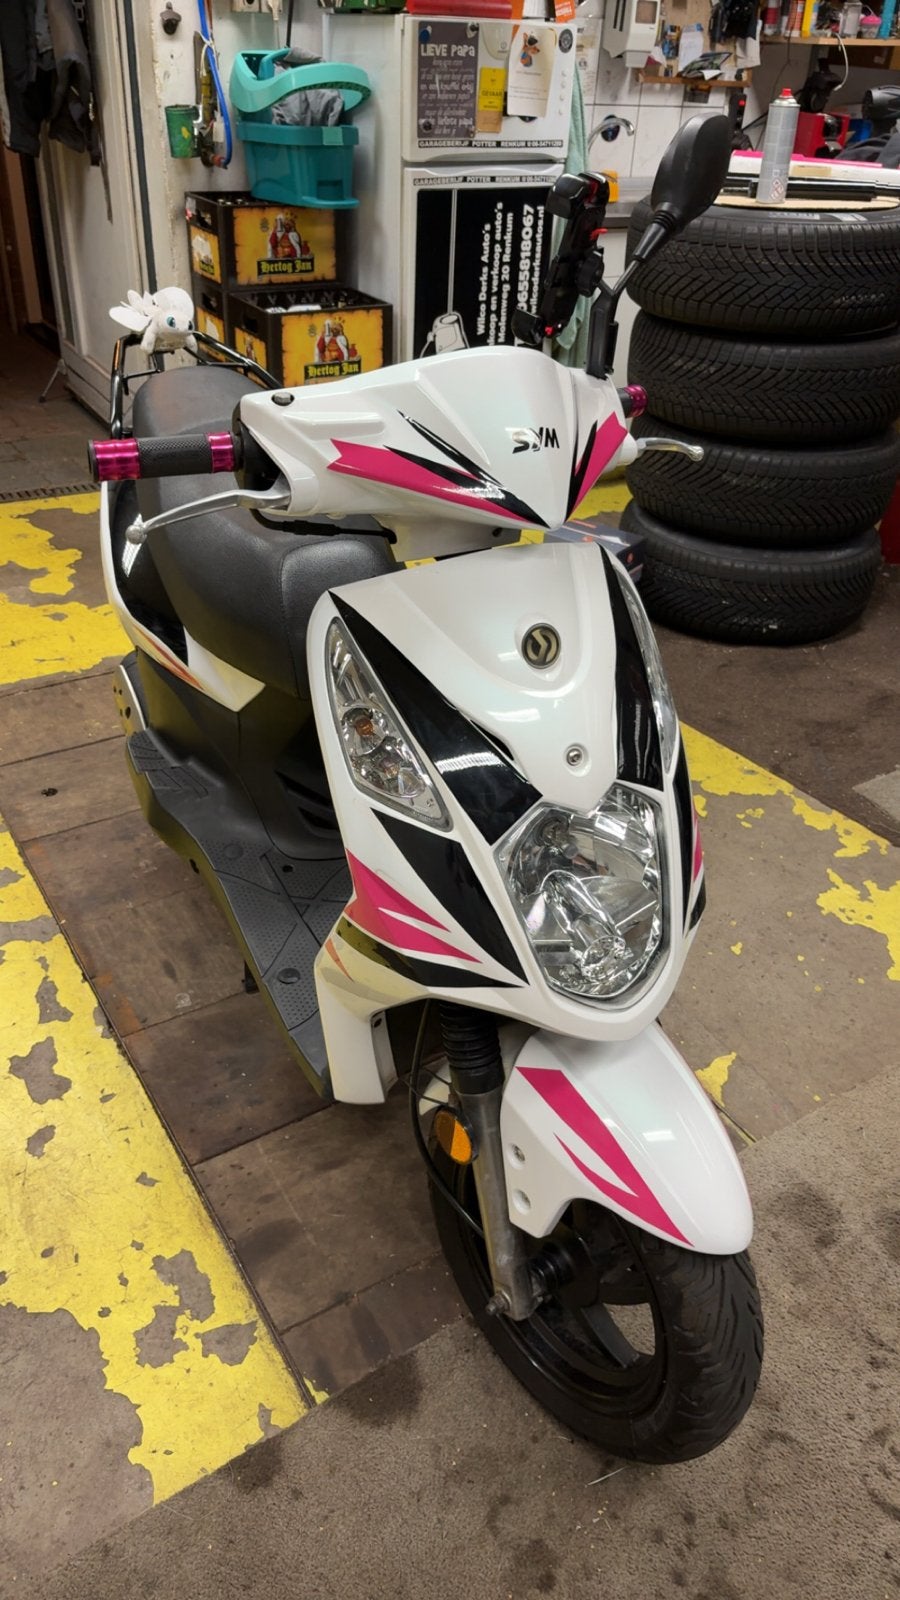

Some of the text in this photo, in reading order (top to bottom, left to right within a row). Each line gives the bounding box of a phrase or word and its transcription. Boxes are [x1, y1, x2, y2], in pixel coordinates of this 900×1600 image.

[421, 44, 447, 56] LIEVE
[261, 259, 312, 273] Hertog Jan
[490, 243, 502, 293] verkoop
[498, 212, 514, 343] Molenweg 20 Renkum
[478, 266, 489, 301] Derks
[490, 295, 498, 311] en
[477, 303, 487, 335] Wilco
[308, 362, 359, 377] Hertog Jan
[511, 427, 560, 454] SYM
